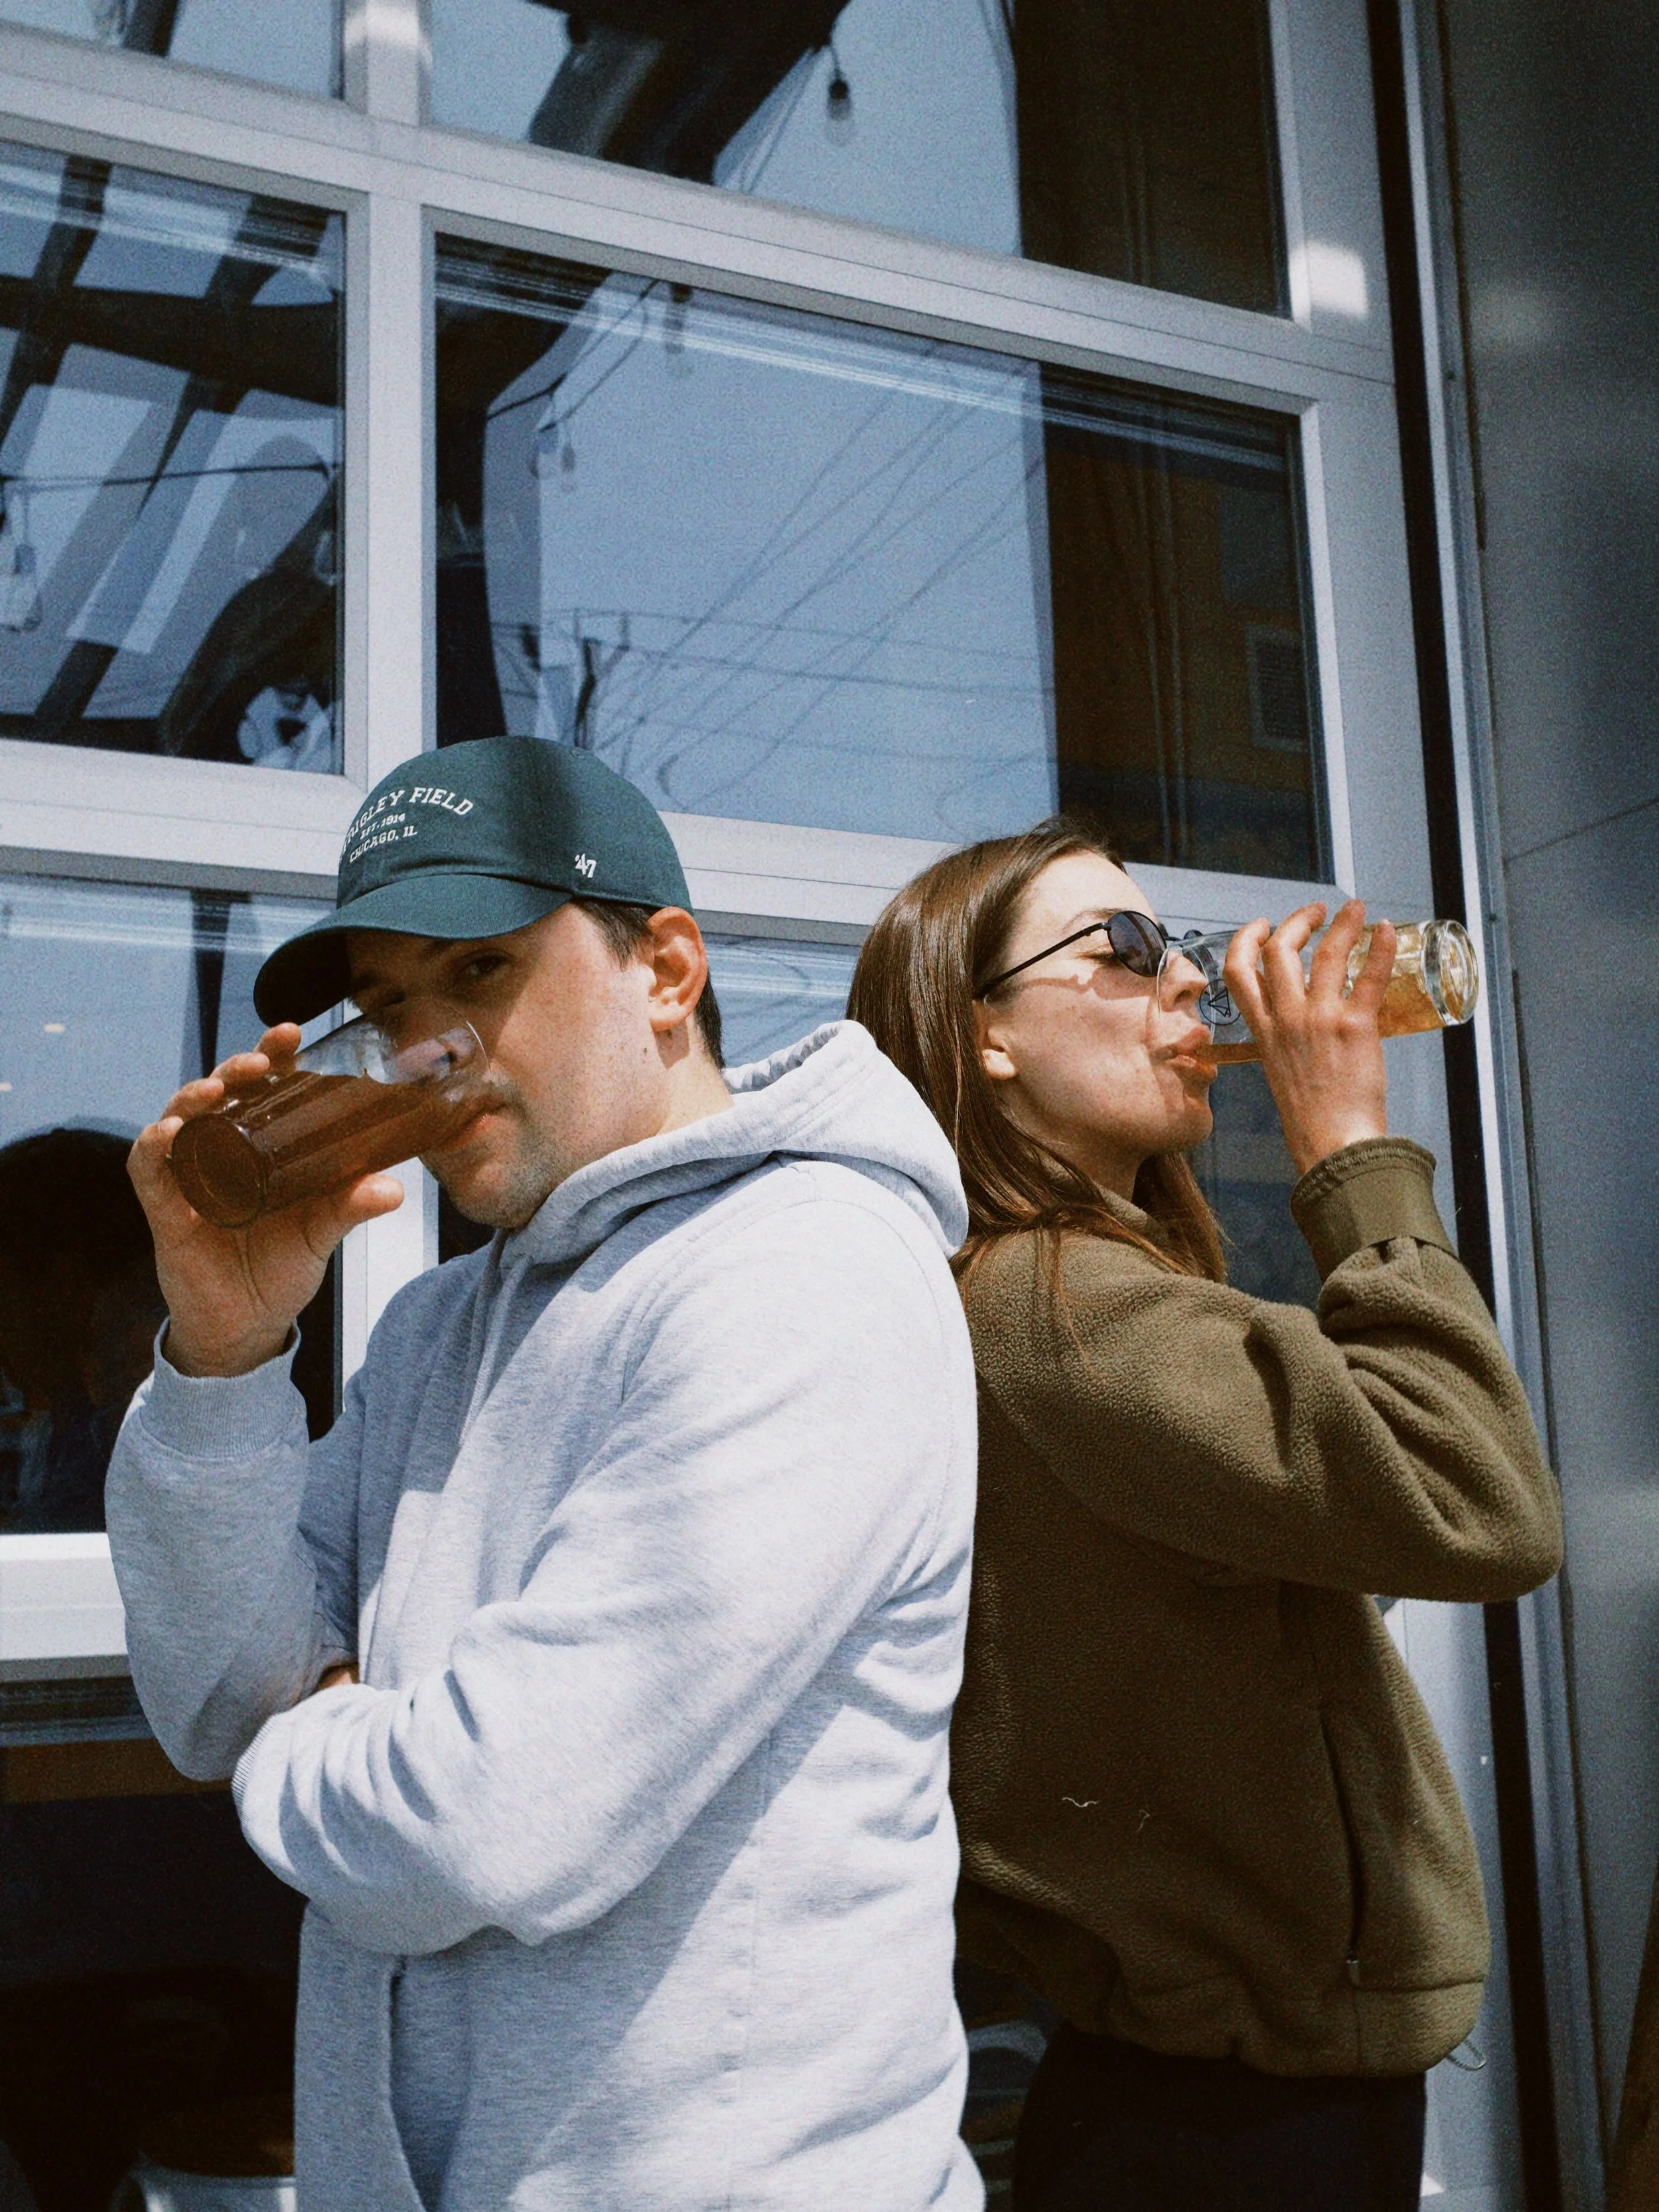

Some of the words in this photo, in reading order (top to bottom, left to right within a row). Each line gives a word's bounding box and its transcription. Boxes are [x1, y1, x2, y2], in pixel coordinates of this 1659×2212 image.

[339, 790, 405, 861] RIGLEY
[409, 787, 473, 815] FIELD
[402, 826, 418, 838] IL
[575, 853, 597, 878] '47
